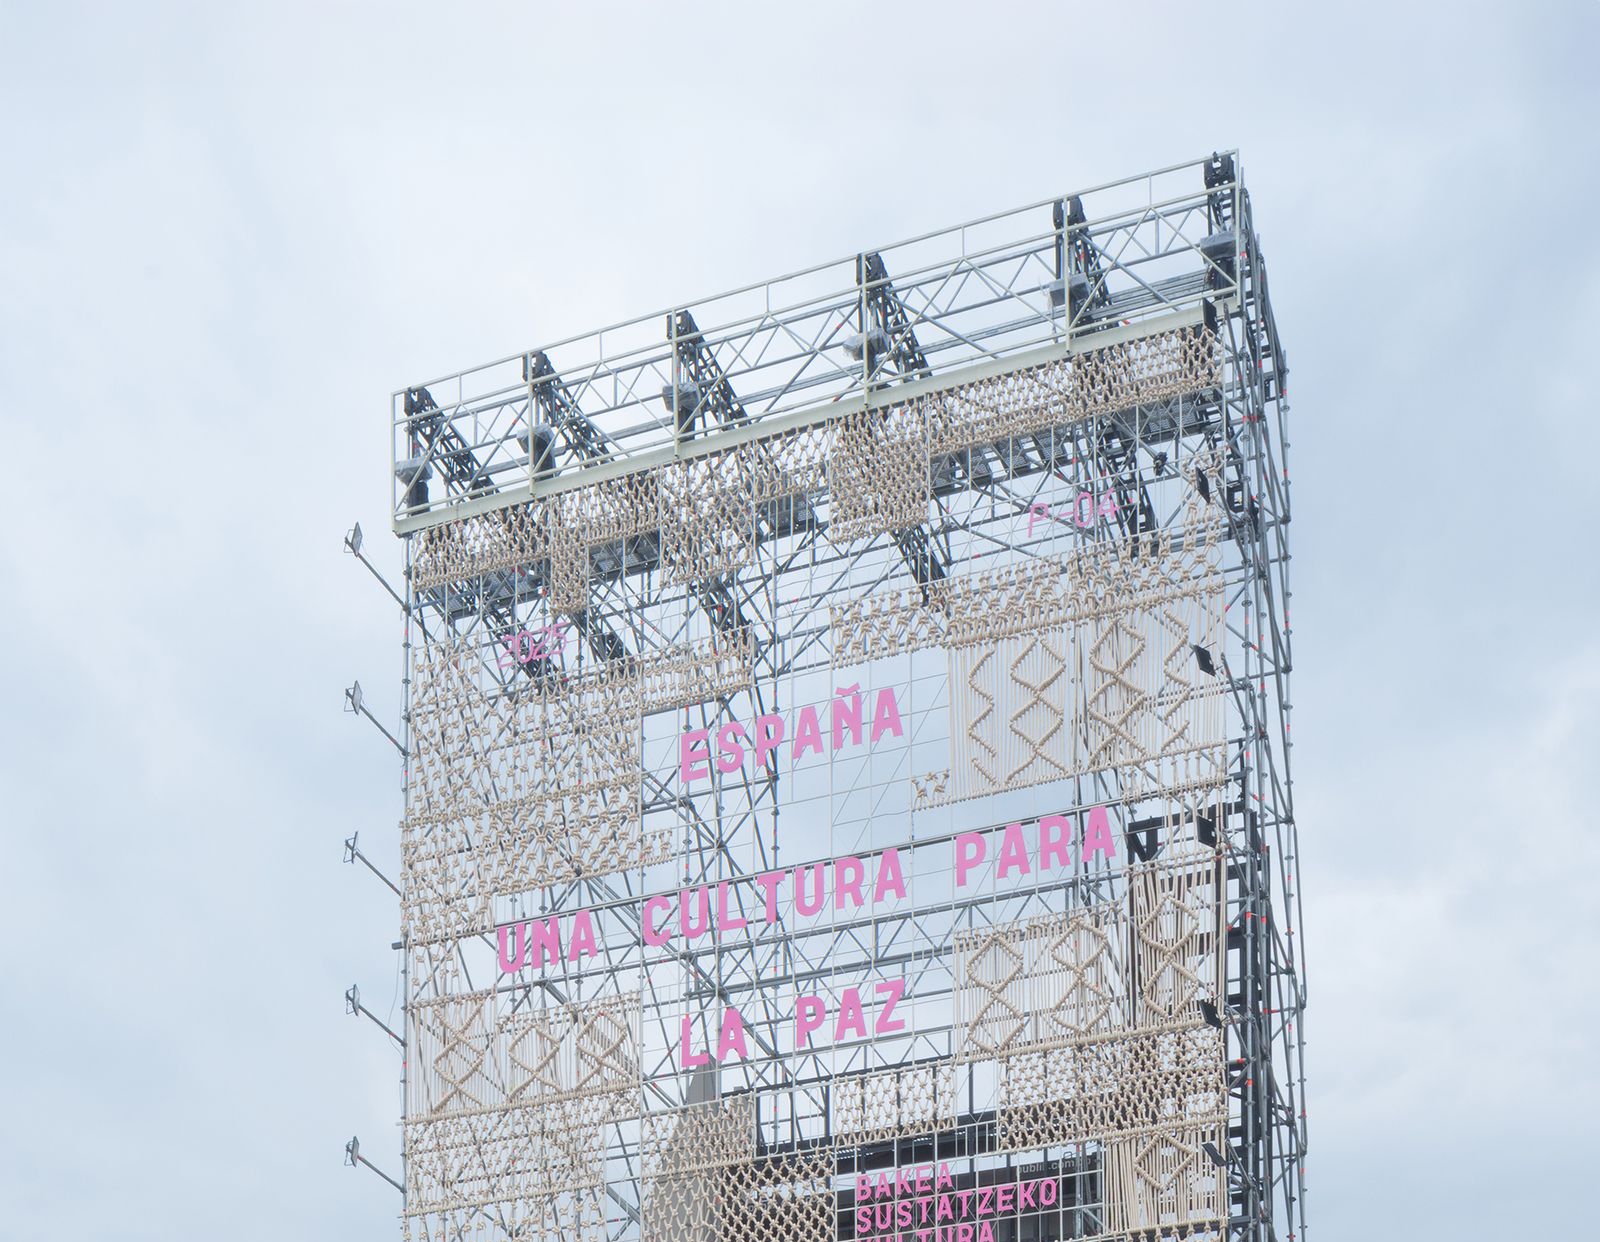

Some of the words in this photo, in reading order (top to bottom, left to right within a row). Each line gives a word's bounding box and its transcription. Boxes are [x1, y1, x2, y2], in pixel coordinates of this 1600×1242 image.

[1028, 487, 1120, 538] P-04
[497, 621, 573, 669] 2025
[681, 683, 903, 783] ESPAÑA
[498, 911, 598, 973] UNA
[643, 847, 906, 947] CULTURA
[955, 806, 1116, 887] PARA
[681, 1008, 748, 1068] LA
[796, 979, 905, 1048] PAZ
[857, 1162, 953, 1202] BAKEA
[857, 1178, 1058, 1234] SUSTATZEKO
